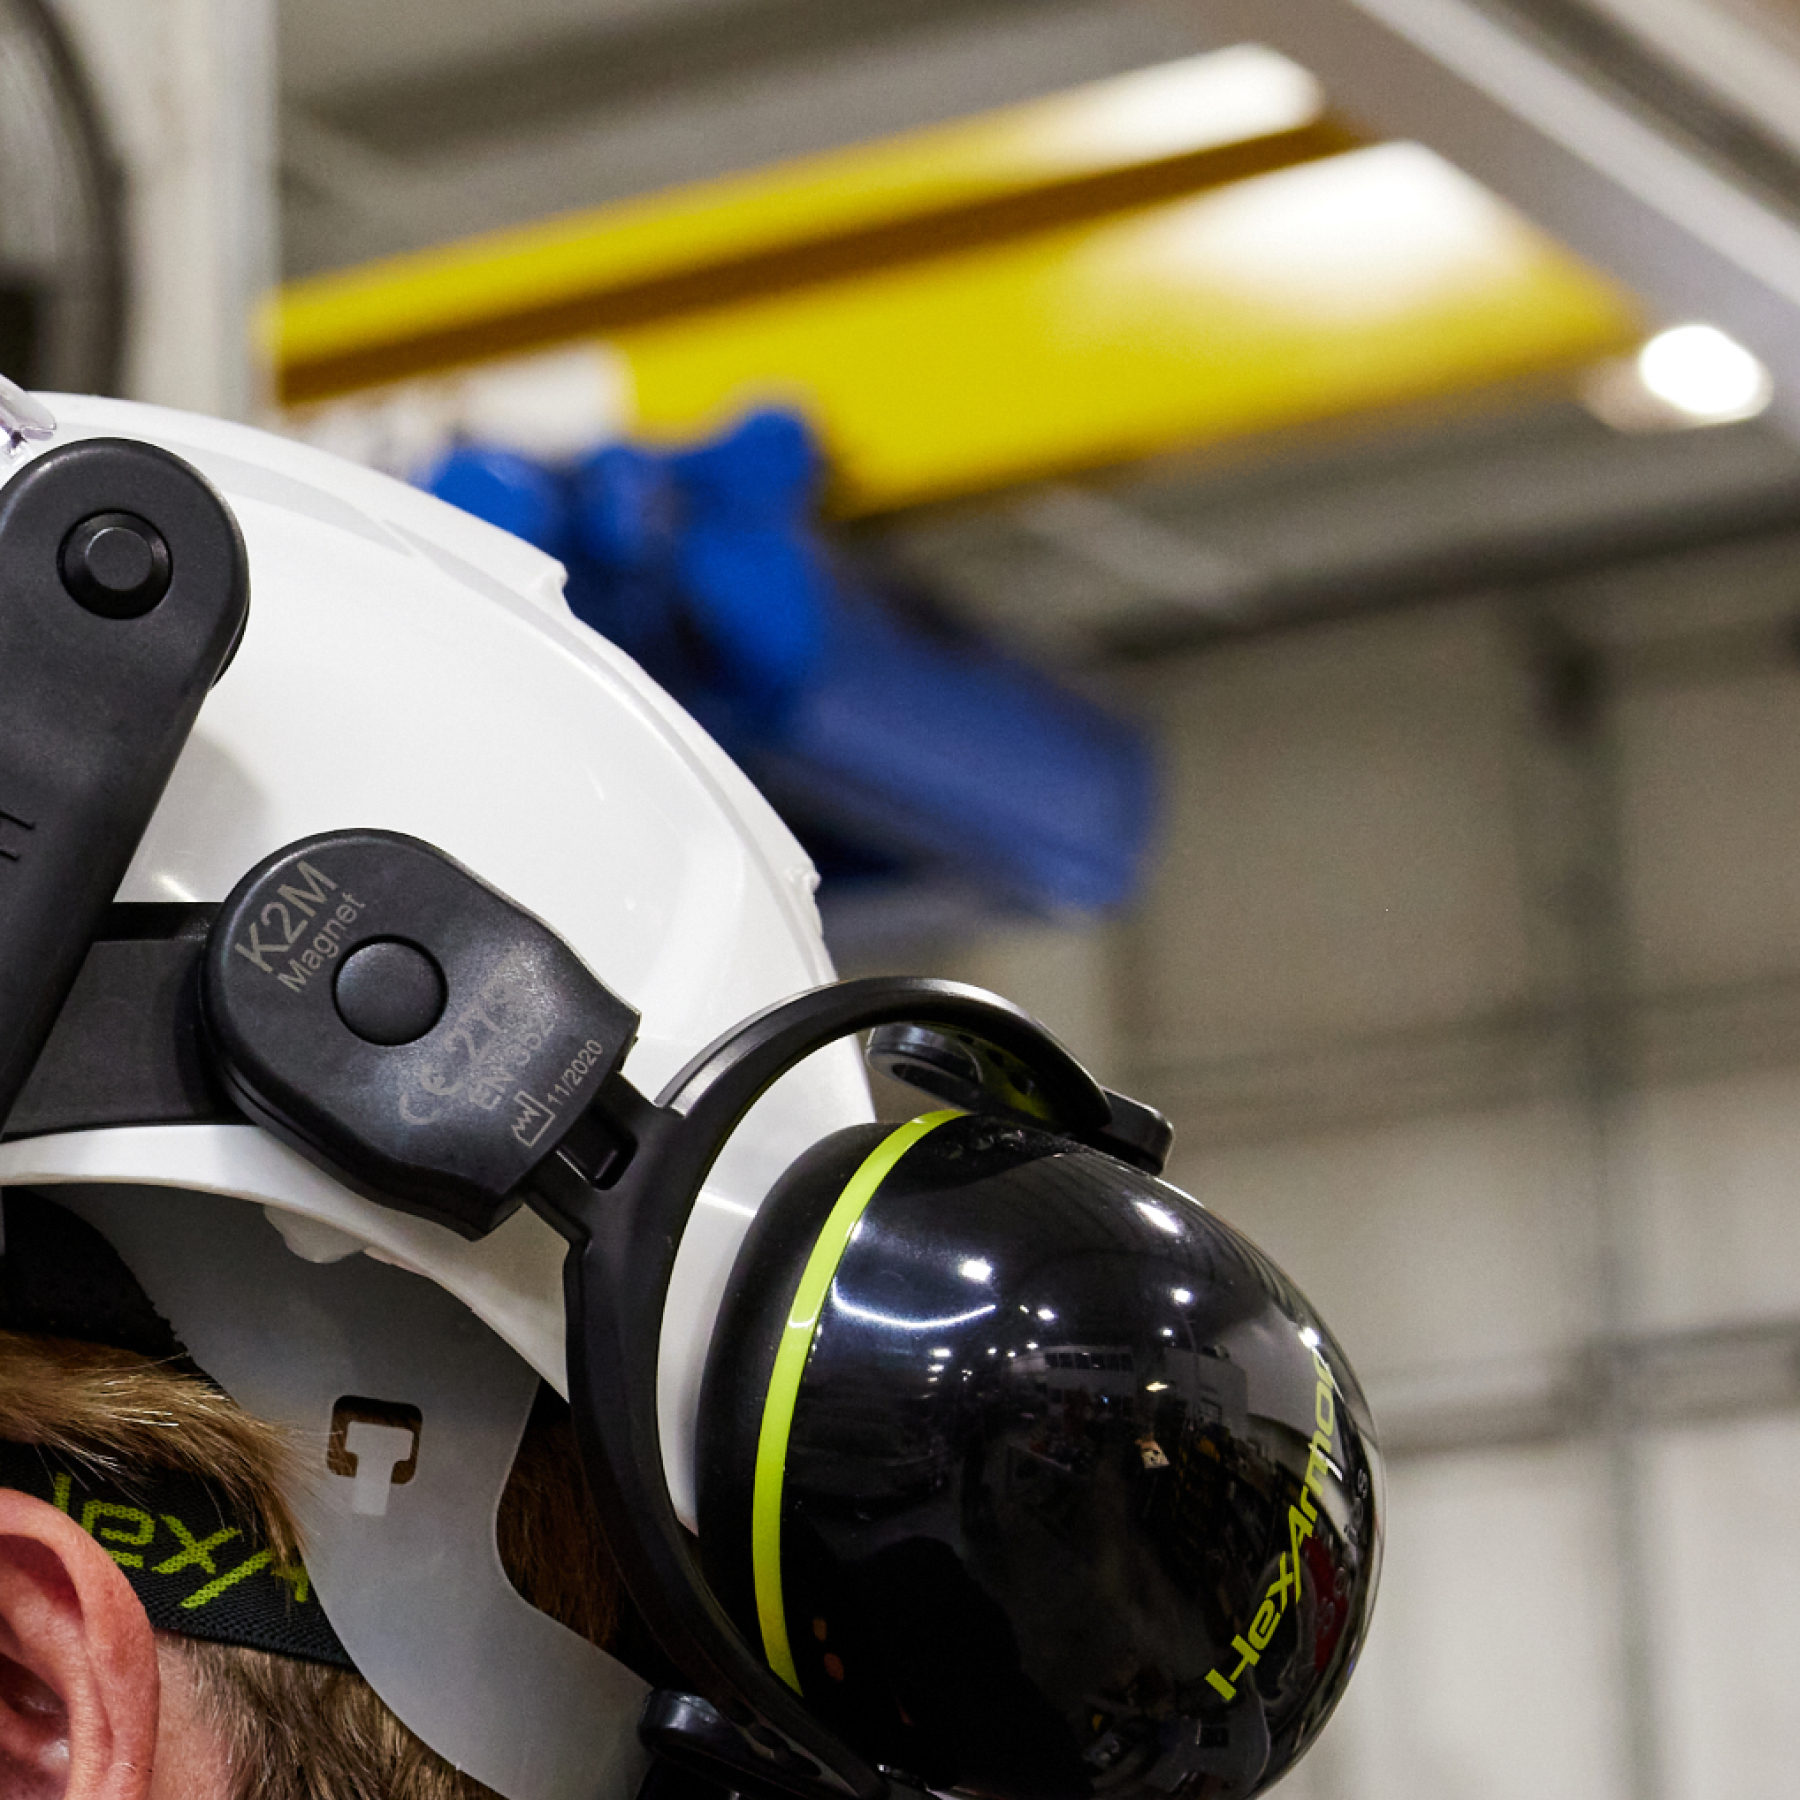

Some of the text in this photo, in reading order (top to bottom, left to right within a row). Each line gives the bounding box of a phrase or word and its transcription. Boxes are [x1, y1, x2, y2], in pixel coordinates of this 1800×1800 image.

[234, 860, 339, 974] K2M
[277, 892, 366, 992] Magnet
[547, 1039, 604, 1106] 11/2020
[1205, 1350, 1336, 1700] HexArmor
